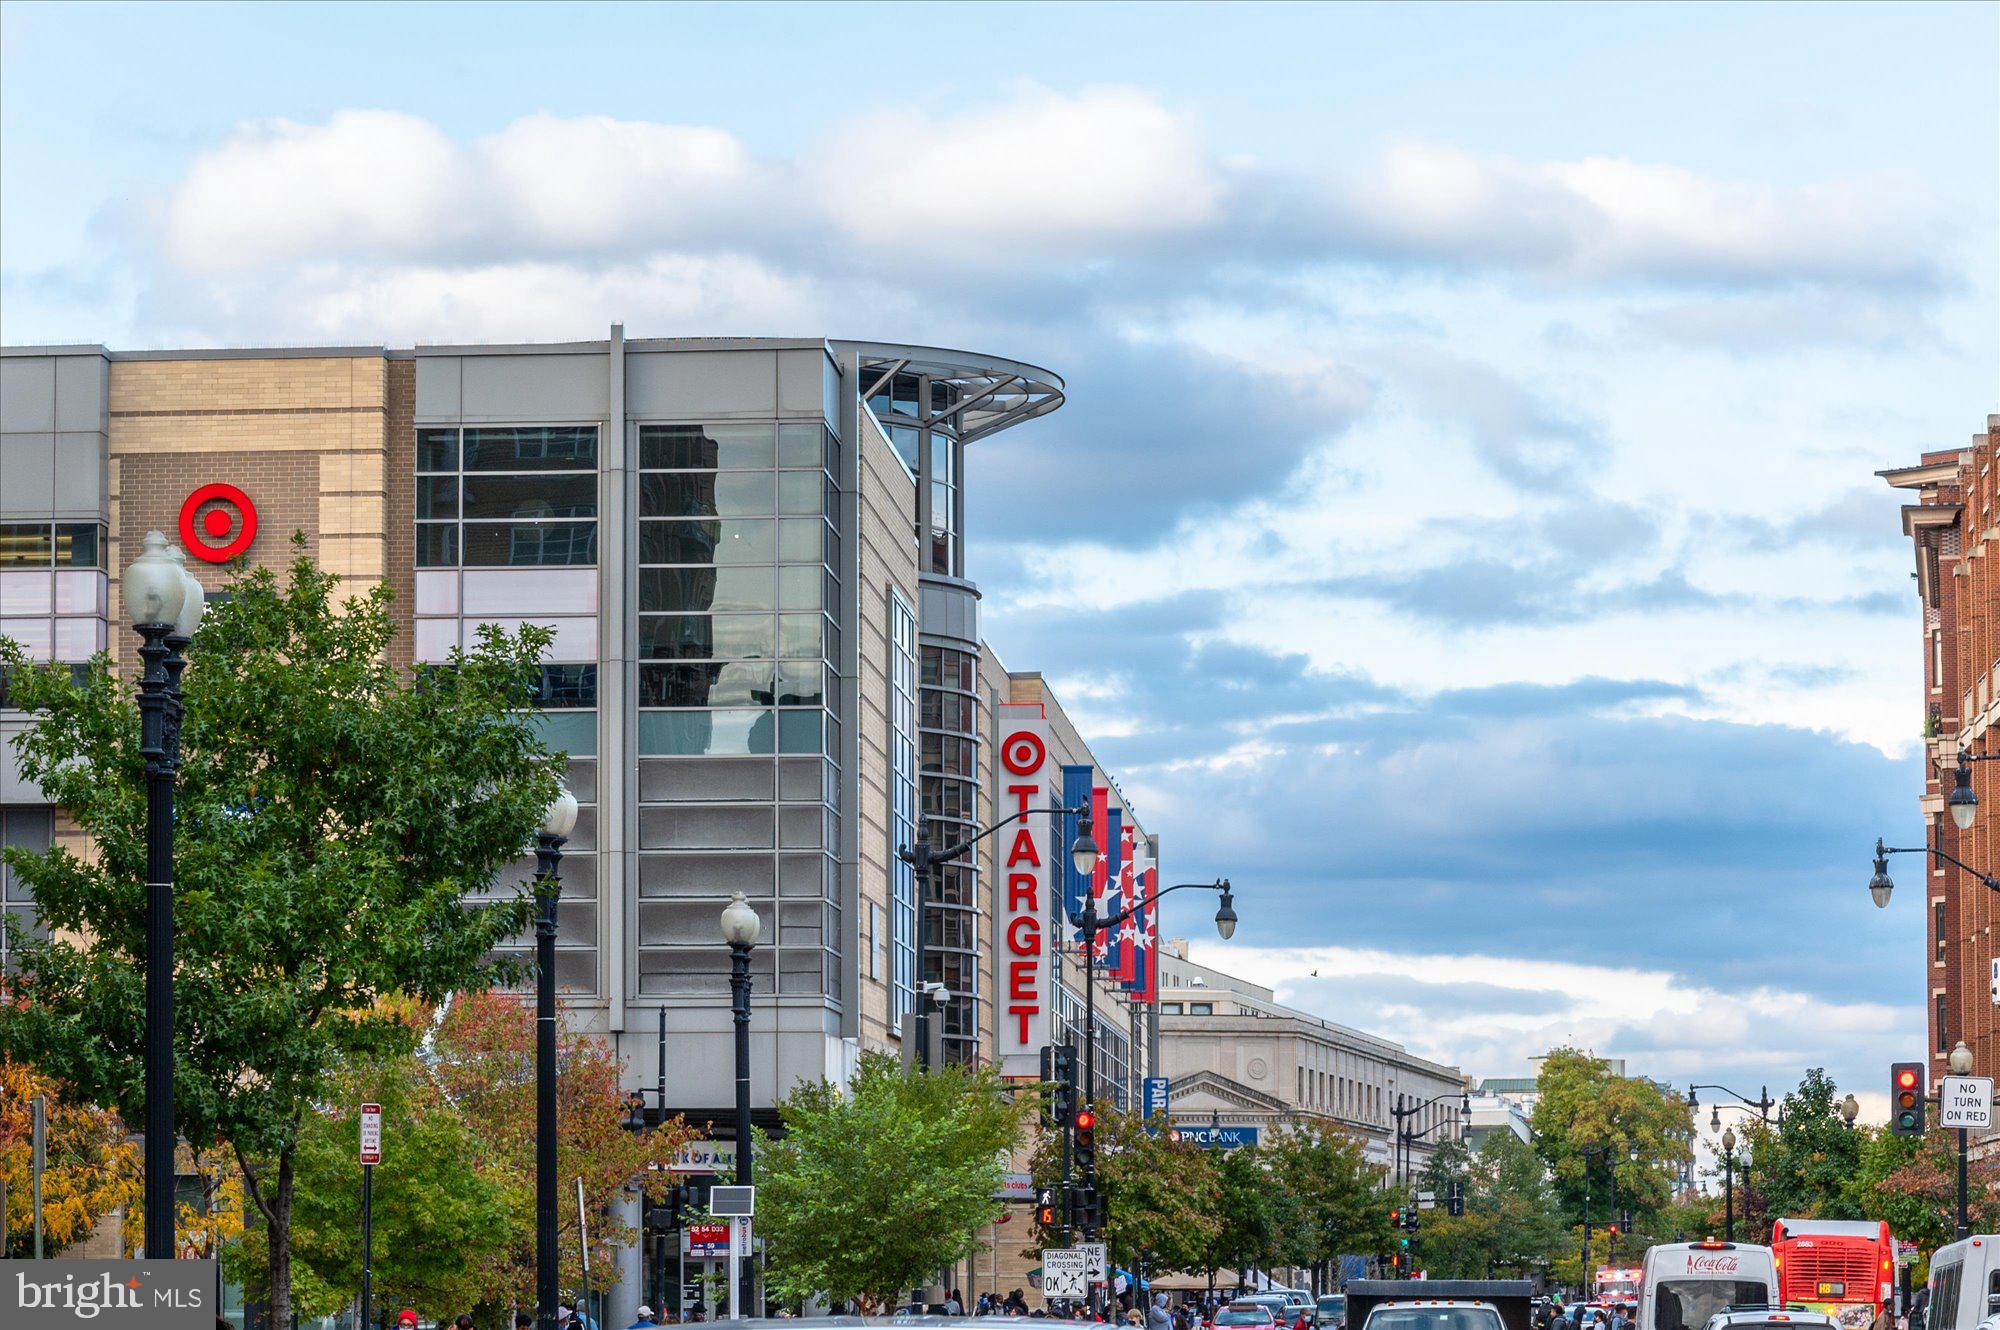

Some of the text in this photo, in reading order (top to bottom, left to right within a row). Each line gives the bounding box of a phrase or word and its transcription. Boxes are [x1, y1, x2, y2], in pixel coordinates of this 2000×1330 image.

[1007, 785, 1042, 1045] TARGET
[1959, 1084, 1977, 1094] NO
[1954, 1097, 1982, 1108] TURN
[1946, 1110, 1987, 1122] ON RED
[1181, 1131, 1240, 1143] PNC BANK
[1046, 1252, 1083, 1260] DIAGONAL
[1087, 1257, 1101, 1266] AY
[1046, 1261, 1083, 1269] CROSSING
[1045, 1276, 1060, 1292] OK
[1819, 1283, 1831, 1294] H8
